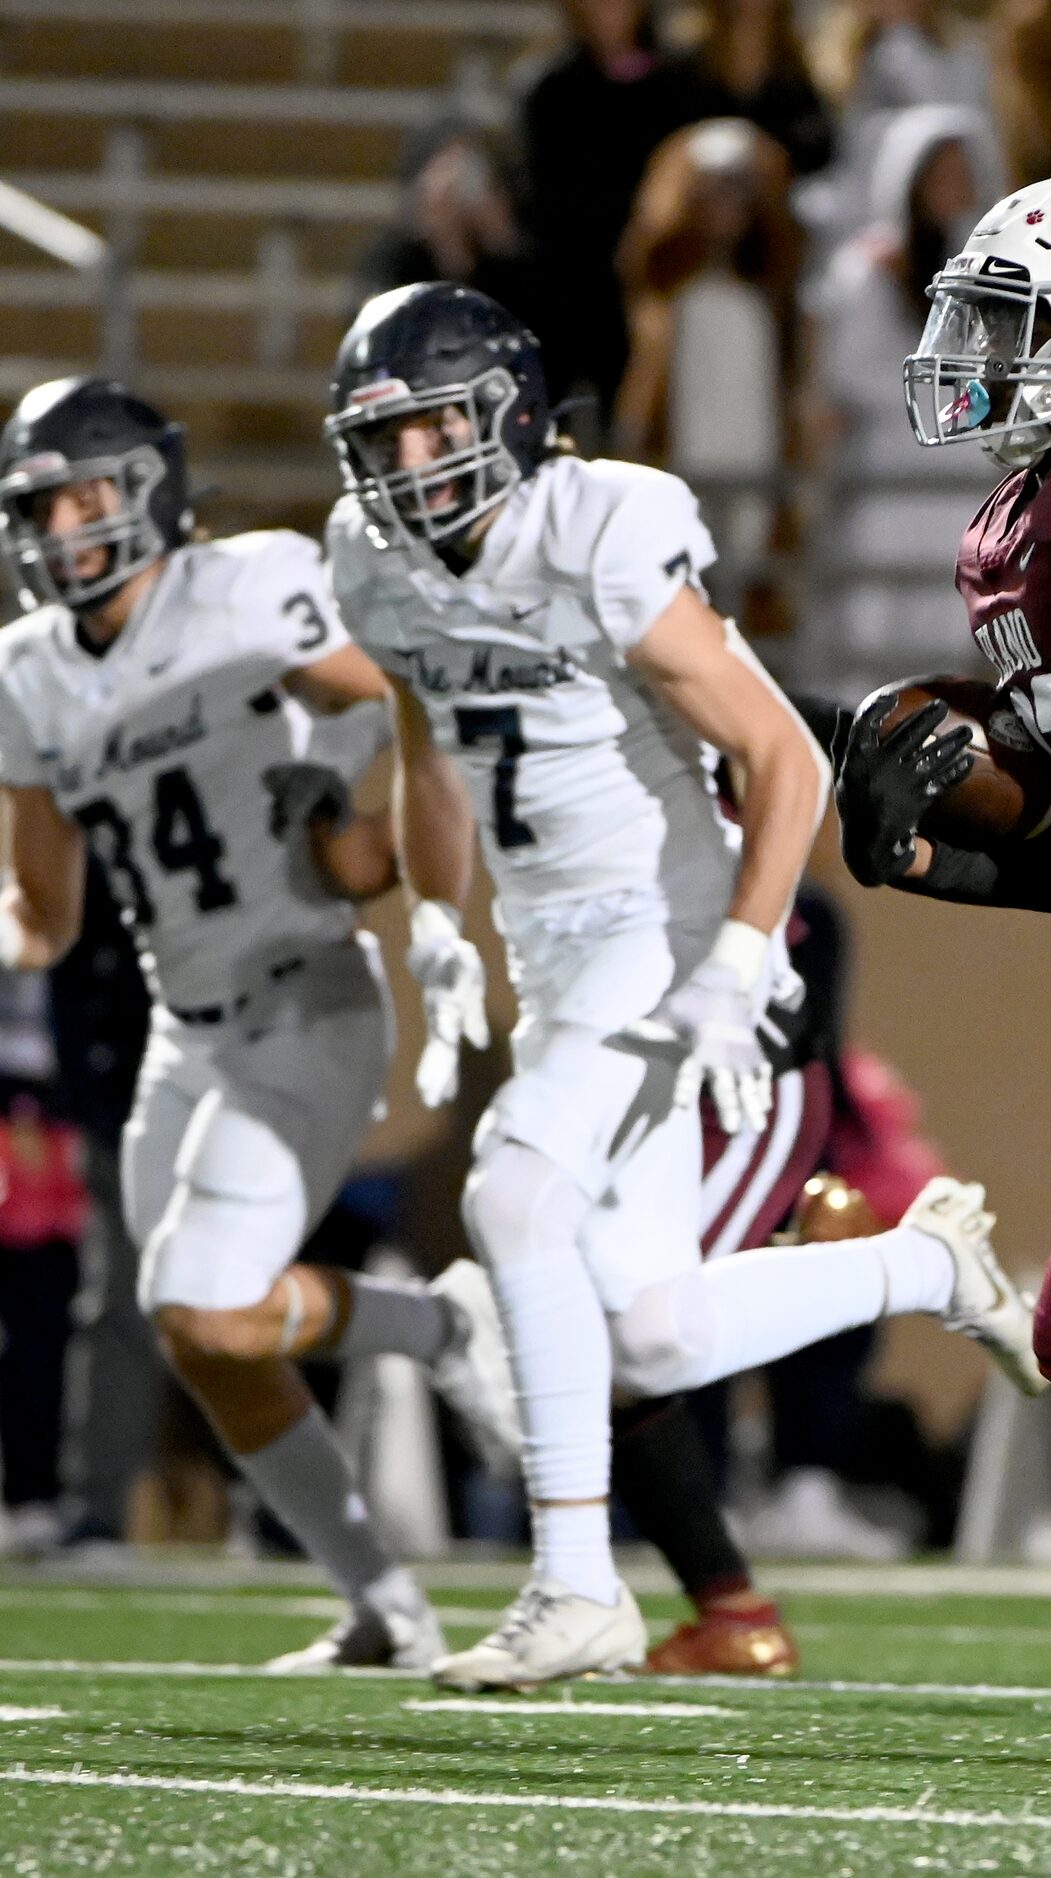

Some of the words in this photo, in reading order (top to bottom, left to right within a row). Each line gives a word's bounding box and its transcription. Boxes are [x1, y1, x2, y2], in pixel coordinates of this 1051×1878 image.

[281, 592, 328, 651] 3
[70, 763, 240, 926] 34
[454, 705, 537, 849] 7
